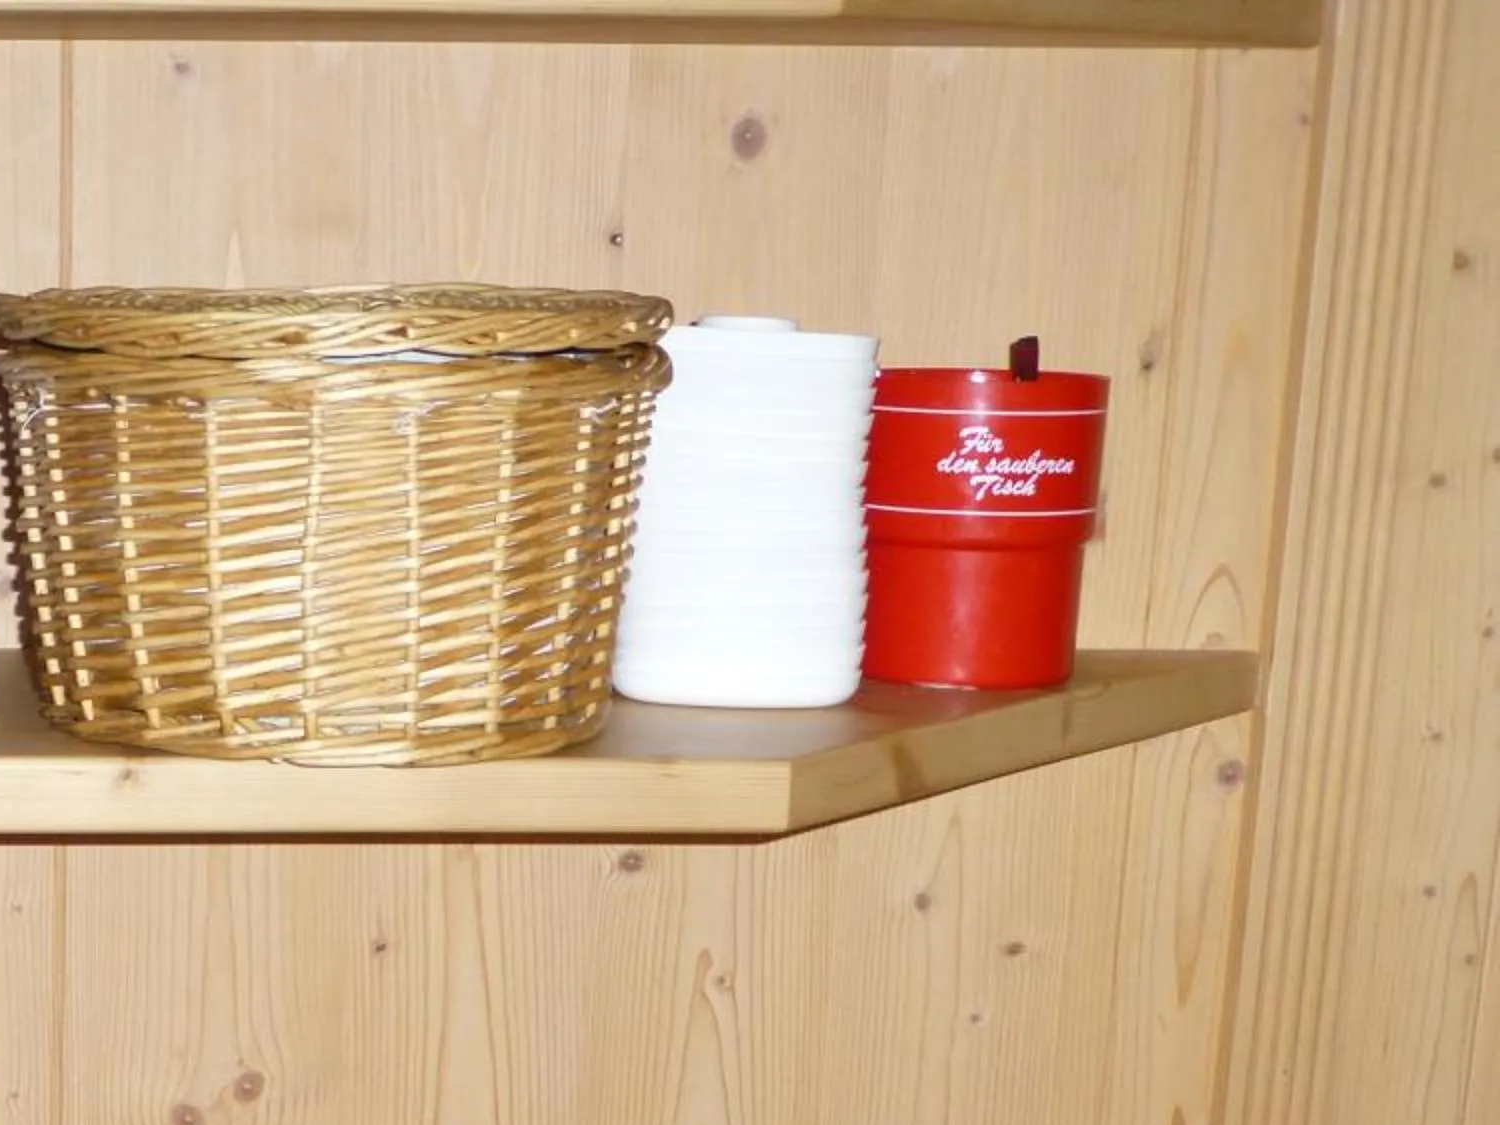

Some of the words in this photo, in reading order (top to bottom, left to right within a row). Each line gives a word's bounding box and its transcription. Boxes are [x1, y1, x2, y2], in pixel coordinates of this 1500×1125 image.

[959, 425, 1005, 456] Für
[936, 452, 983, 474] den
[986, 450, 1076, 474] sauberen
[969, 474, 1037, 501] Tisch
